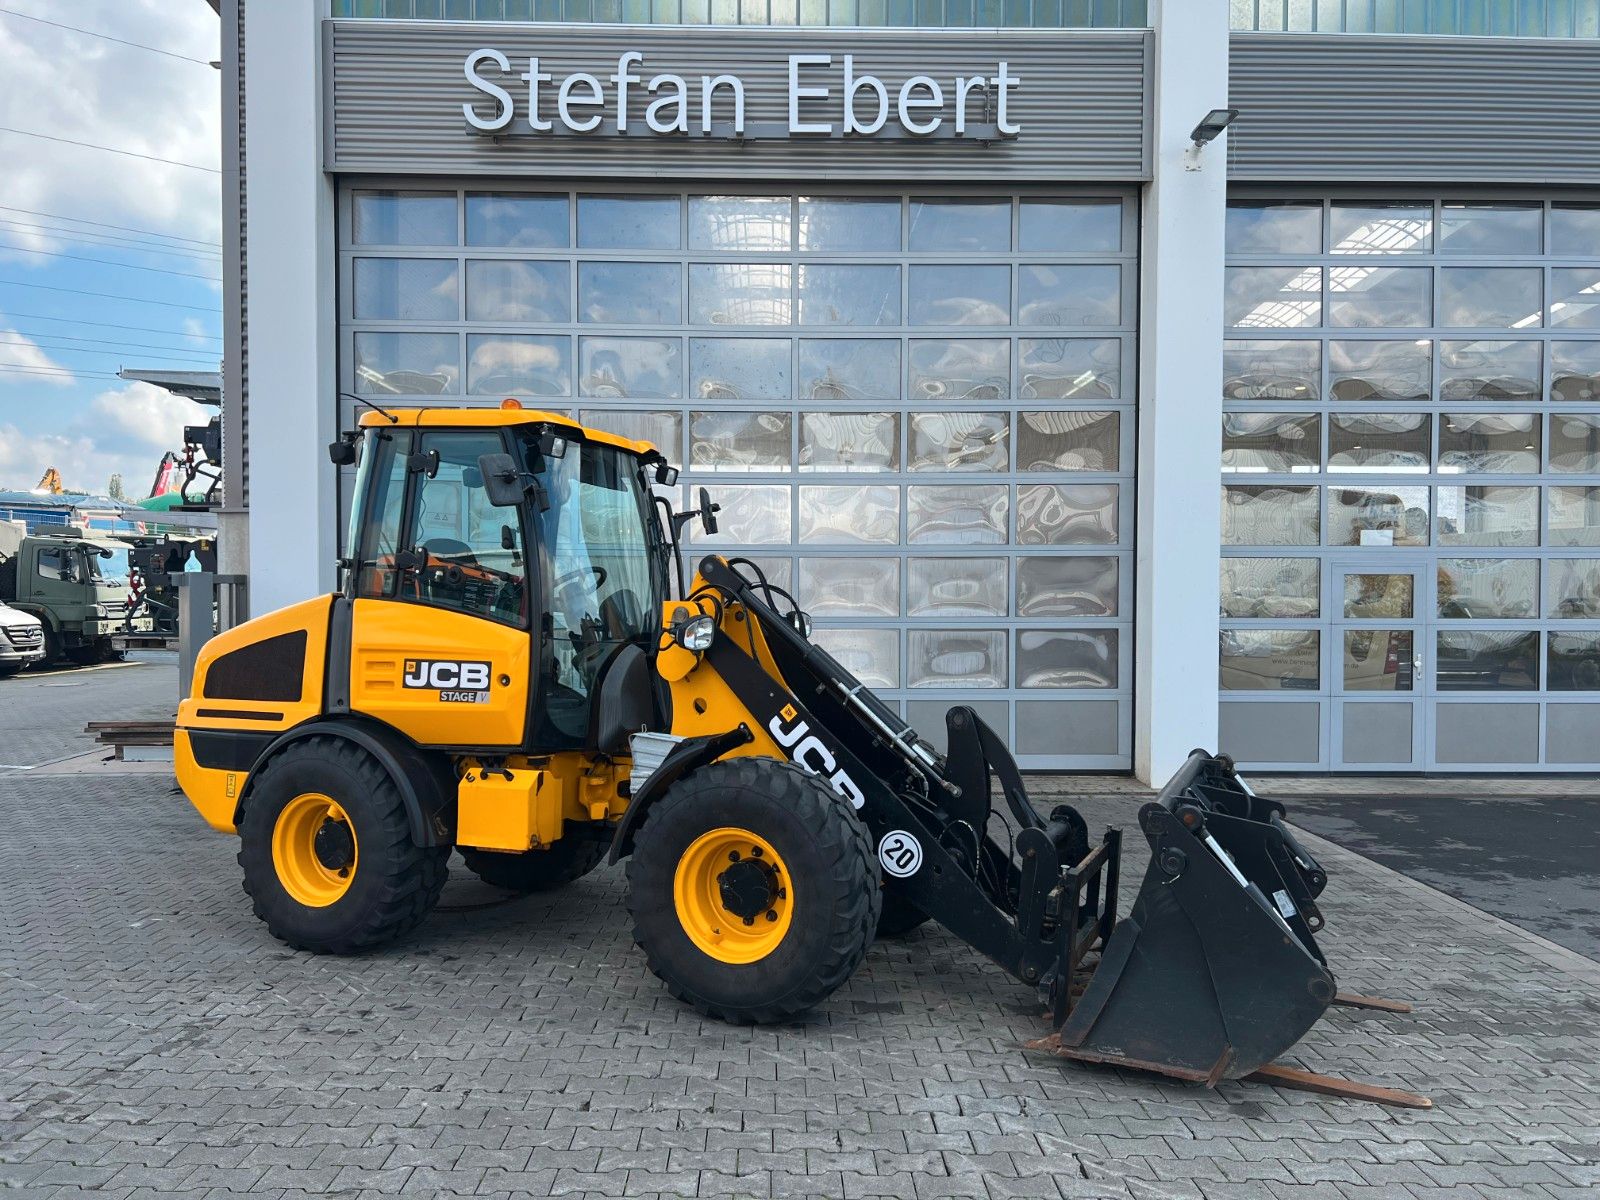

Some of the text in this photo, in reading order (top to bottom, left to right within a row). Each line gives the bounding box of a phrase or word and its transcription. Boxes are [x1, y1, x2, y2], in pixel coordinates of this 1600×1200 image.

[462, 48, 1021, 136] Stefan Ebert
[405, 662, 489, 689] JCB
[440, 691, 475, 702] STAGE
[883, 838, 916, 870] 20
